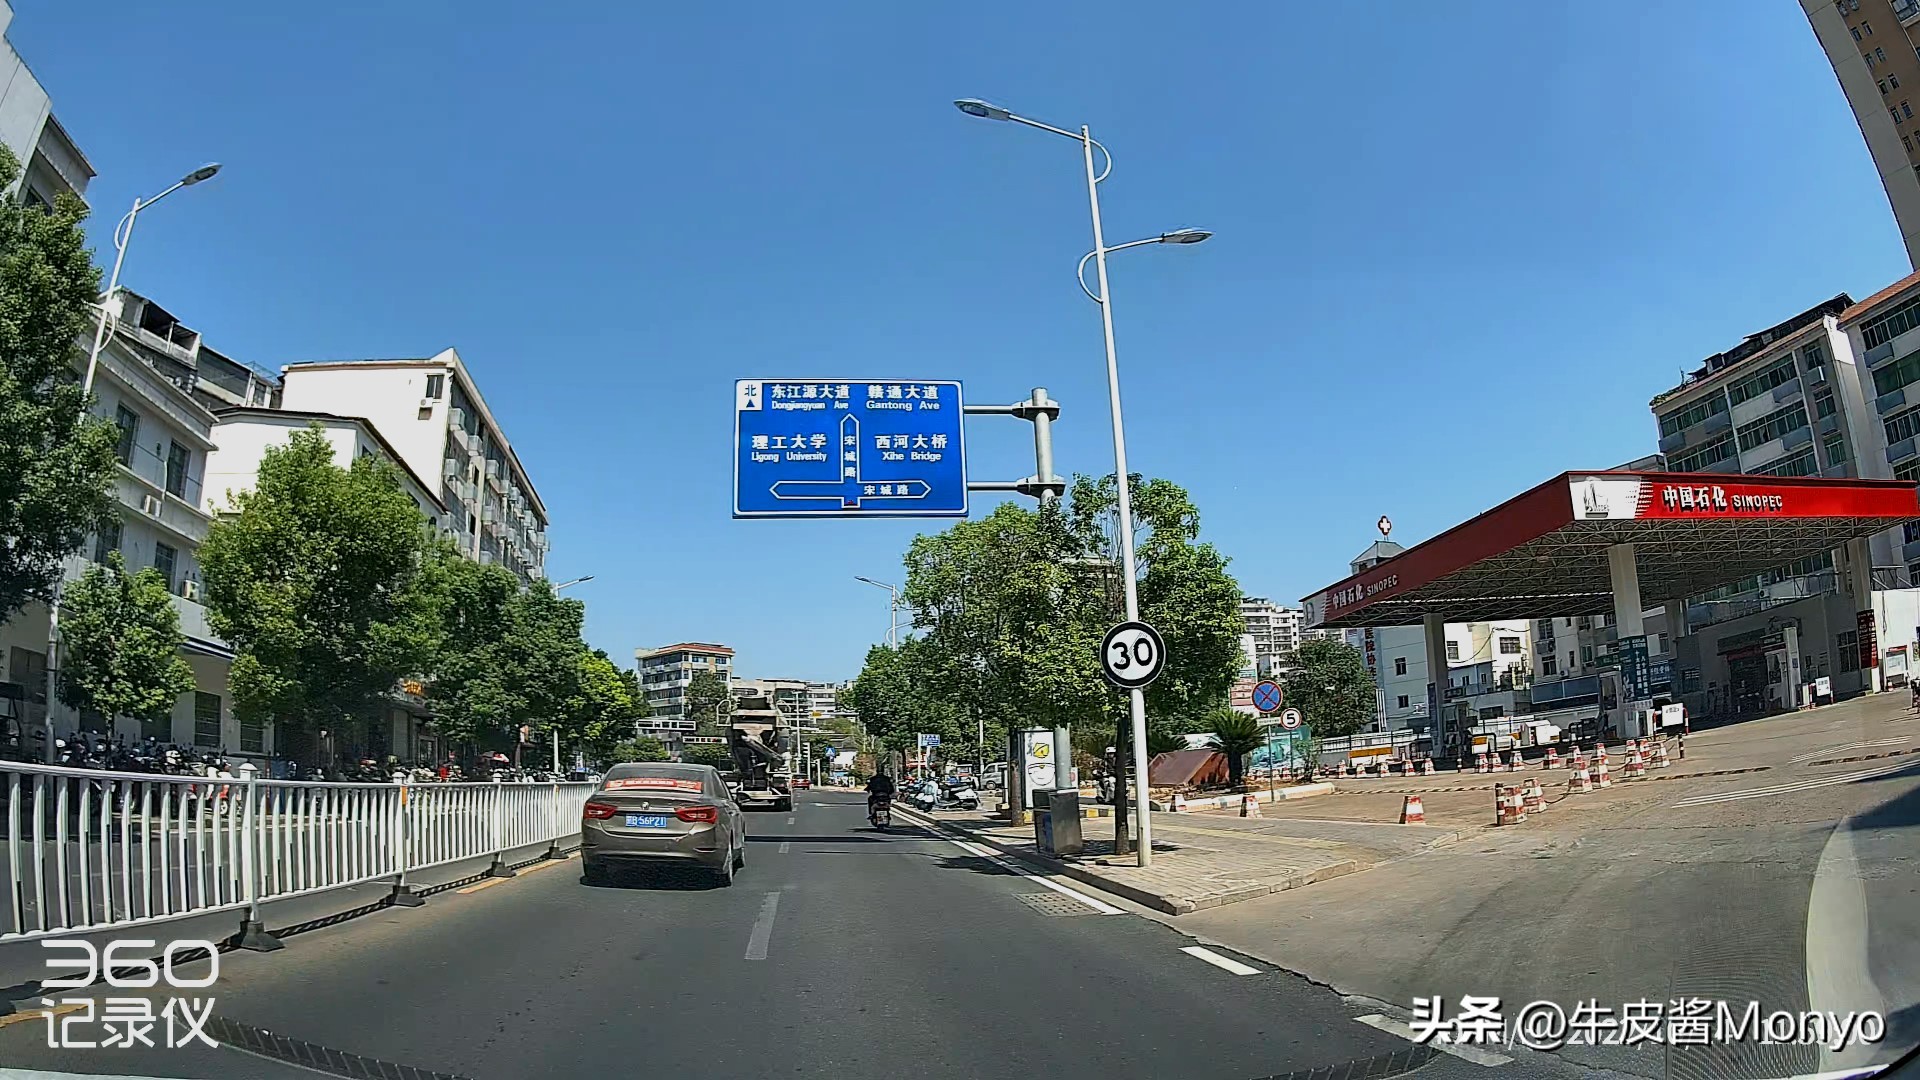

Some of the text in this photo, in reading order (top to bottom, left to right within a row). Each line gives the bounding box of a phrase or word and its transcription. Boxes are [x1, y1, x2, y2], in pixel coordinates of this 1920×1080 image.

[745, 385, 757, 397] 北
[771, 385, 939, 399] 东江源大道 赣通大道
[834, 401, 849, 409] Ave
[866, 401, 913, 411] Gantong
[919, 401, 940, 410] Ave
[752, 435, 827, 449] 理工大学
[875, 435, 948, 449] 西河大桥
[751, 452, 827, 462] Ligong University
[844, 435, 856, 477] 宋城路
[882, 452, 941, 462] Xihe Bridge
[863, 485, 909, 495] 宋城路
[1663, 486, 1783, 509] 中国石化 SINOPEC
[1333, 575, 1399, 609] 中国石化 SINOPEC
[1112, 638, 1153, 670] 30
[1286, 713, 1296, 725] 5
